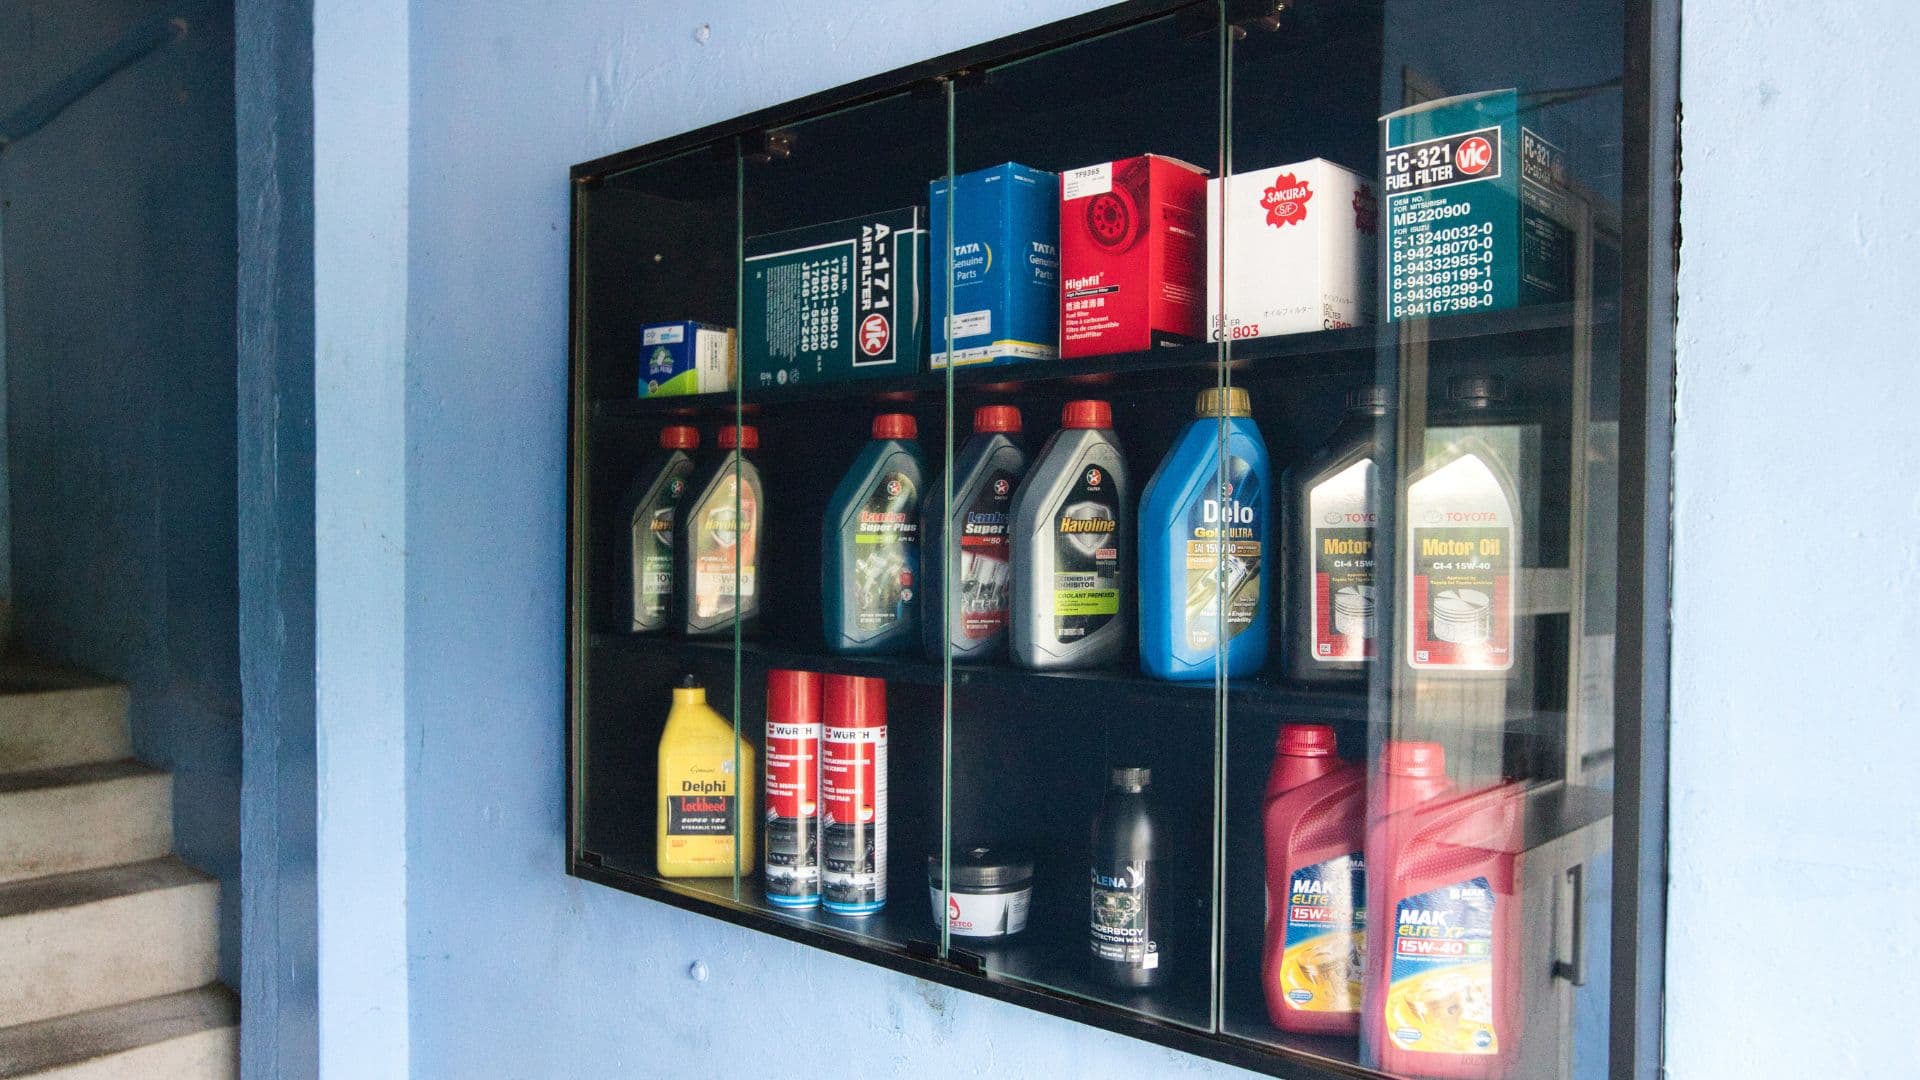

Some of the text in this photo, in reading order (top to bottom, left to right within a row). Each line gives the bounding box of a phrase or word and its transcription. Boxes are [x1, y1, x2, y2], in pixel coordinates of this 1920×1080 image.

[1386, 144, 1451, 174] FC-321
[1386, 166, 1453, 190] FUEL FILTER
[1267, 187, 1307, 203] SAKURA
[1394, 198, 1409, 206] OEM
[1394, 199, 1447, 213] FOR MITSUBISHI
[1394, 203, 1470, 226] MB220900
[1394, 224, 1430, 235] FOR ISUZU
[1394, 222, 1493, 248] 5-13240032-0
[955, 242, 979, 256] TATA
[1032, 241, 1055, 255] TATA
[1394, 236, 1493, 262] 8-94248070-0
[862, 225, 873, 311] AIR FILTER
[874, 223, 890, 309] A-171
[953, 256, 983, 271] Genuine
[1394, 251, 1493, 276] 8-94332955-0
[957, 270, 977, 281] Parts
[1035, 267, 1053, 280] Parts
[1394, 265, 1492, 291] 8-94369199-1
[1066, 275, 1100, 290] Highfil
[1394, 279, 1493, 304] 8-94369299-0
[1394, 294, 1493, 318] 8-94167398-0
[1204, 499, 1254, 524] Delo
[1344, 513, 1377, 522] TOYO
[1445, 512, 1497, 522] TOYOTA
[860, 523, 918, 532] Super Plus
[966, 523, 1004, 534] Super
[1060, 517, 1116, 533] Havoline
[1230, 527, 1253, 538] ULTRA
[1324, 538, 1372, 555] Motor
[1423, 539, 1501, 556] Motor Oil
[1456, 562, 1491, 570] 15W-40
[683, 780, 727, 794] Delphi
[682, 796, 727, 812] Lockheed
[1293, 879, 1334, 894] MAK
[1292, 894, 1329, 906] ELITE
[1399, 909, 1448, 925] MAK
[1399, 925, 1441, 937] ELITE
[1401, 940, 1463, 954] 15W-40
